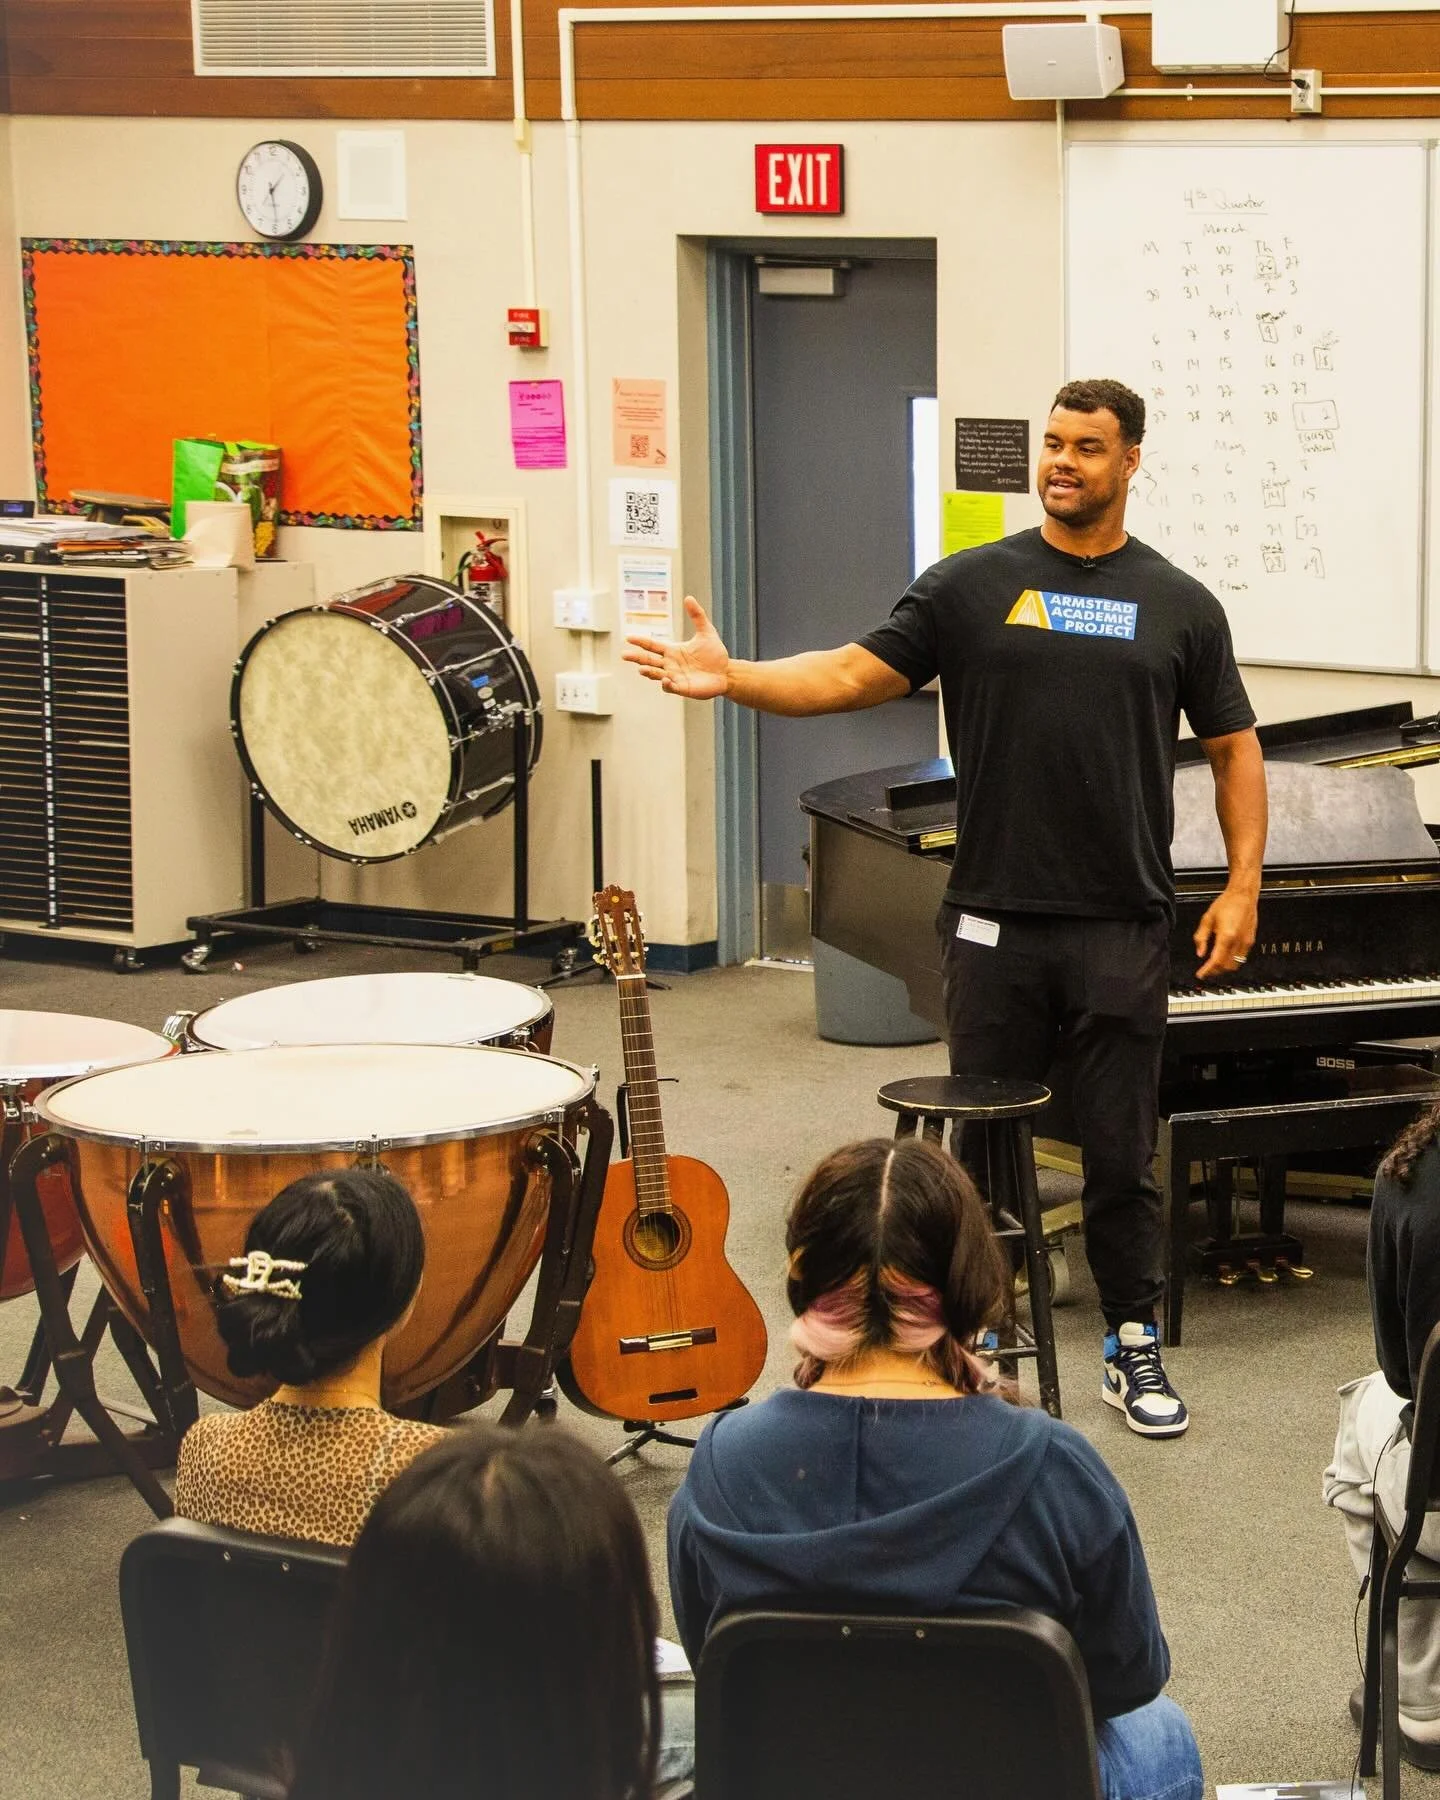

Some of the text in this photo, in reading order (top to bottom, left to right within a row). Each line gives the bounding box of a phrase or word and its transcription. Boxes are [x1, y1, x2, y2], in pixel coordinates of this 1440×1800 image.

[768, 152, 831, 206] EXIT
[1212, 187, 1265, 210] Quarter
[1202, 223, 1249, 237] March
[1142, 240, 1160, 256] M
[1181, 241, 1193, 255] T
[1217, 263, 1233, 277] 25
[1285, 255, 1300, 270] 27
[1183, 286, 1200, 299] 31
[1289, 279, 1298, 295] 3
[1218, 355, 1233, 371] 15
[1263, 410, 1278, 425] 30
[1214, 439, 1246, 456] May
[1301, 486, 1317, 502] 15
[1049, 594, 1134, 614] ARMSTEAD
[1051, 606, 1134, 626] ACADEMIC
[1064, 620, 1132, 637] PROJECT
[347, 806, 404, 836] YAMAHA
[1261, 939, 1325, 955] YAMAHA
[1315, 1055, 1356, 1070] BOSS
